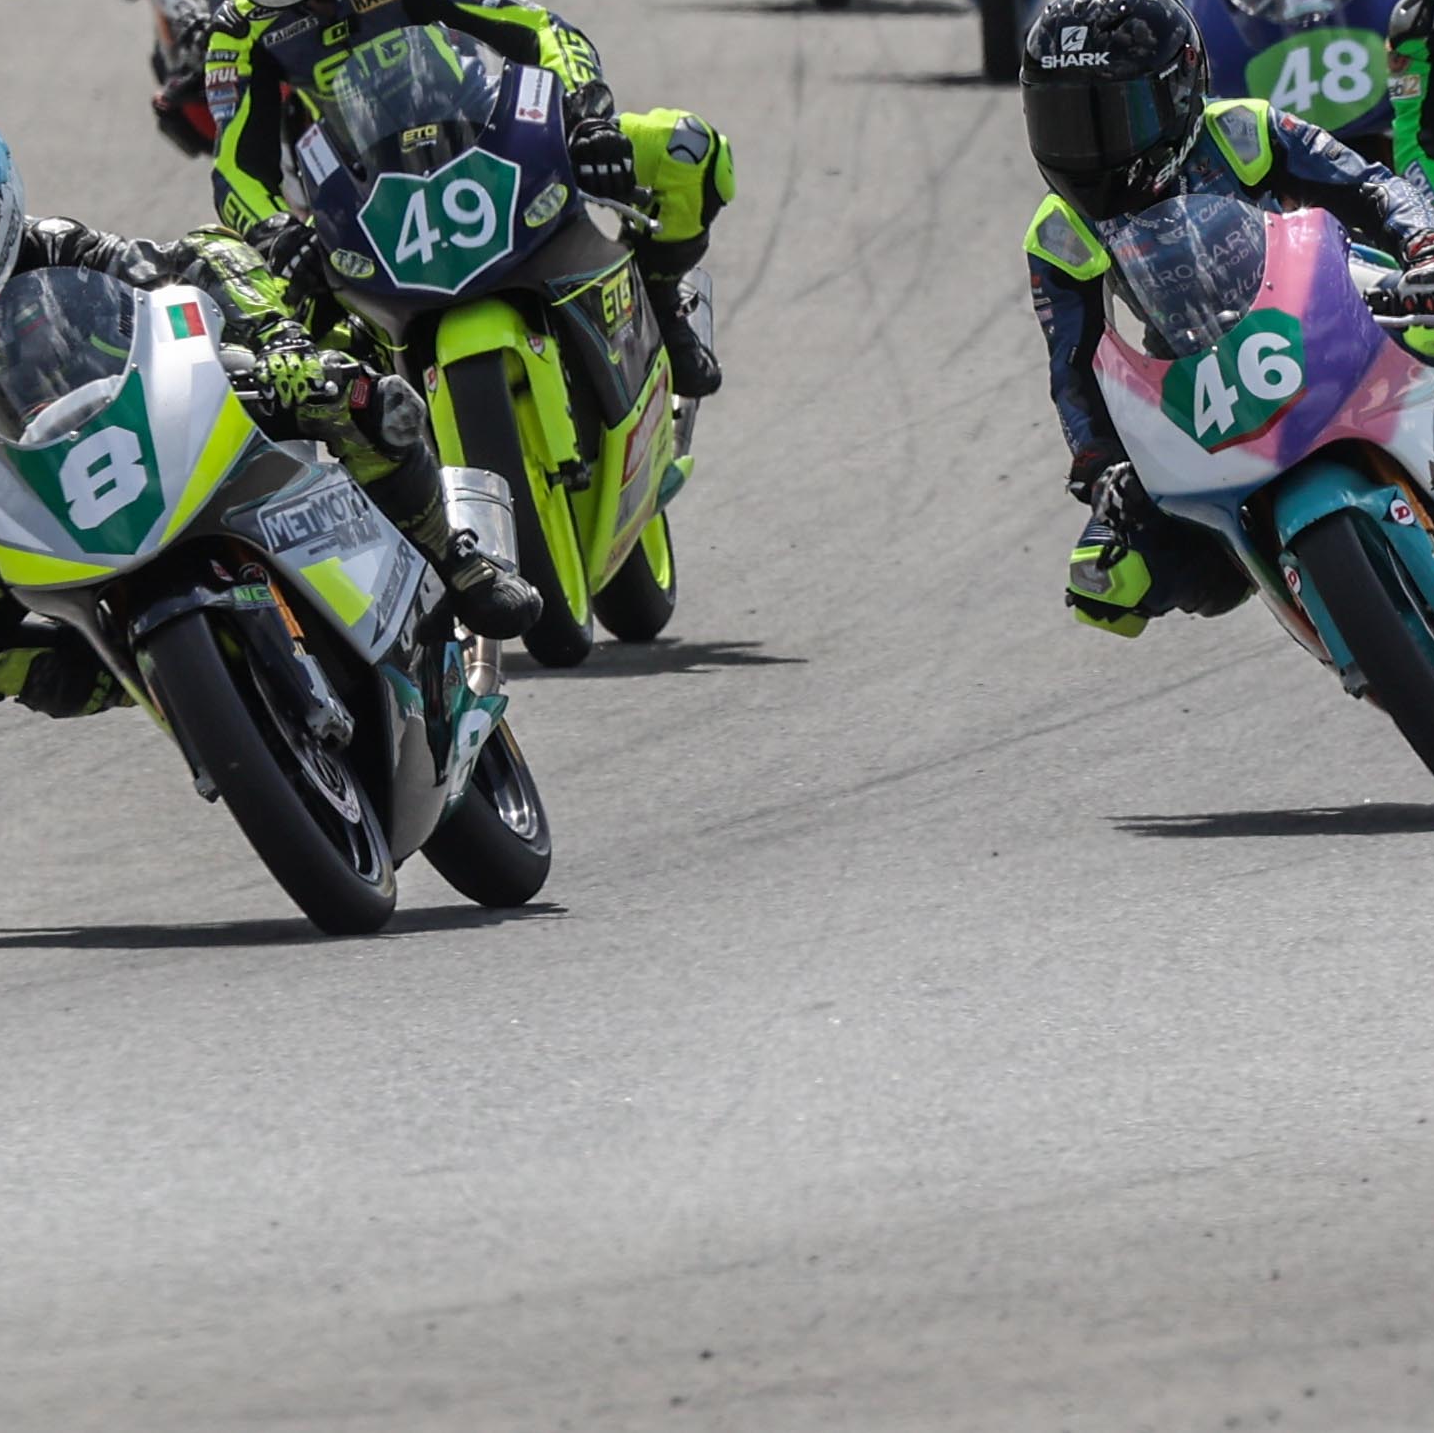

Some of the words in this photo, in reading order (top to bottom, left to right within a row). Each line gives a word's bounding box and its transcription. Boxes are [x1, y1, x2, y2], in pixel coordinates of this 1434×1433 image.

[313, 27, 410, 94] ETG
[1040, 51, 1112, 70] SHARK
[1269, 38, 1373, 113] 48
[403, 123, 438, 143] ETG
[393, 177, 498, 266] 49
[601, 268, 632, 323] ETG
[1191, 330, 1304, 442] 46
[57, 424, 149, 530] 8
